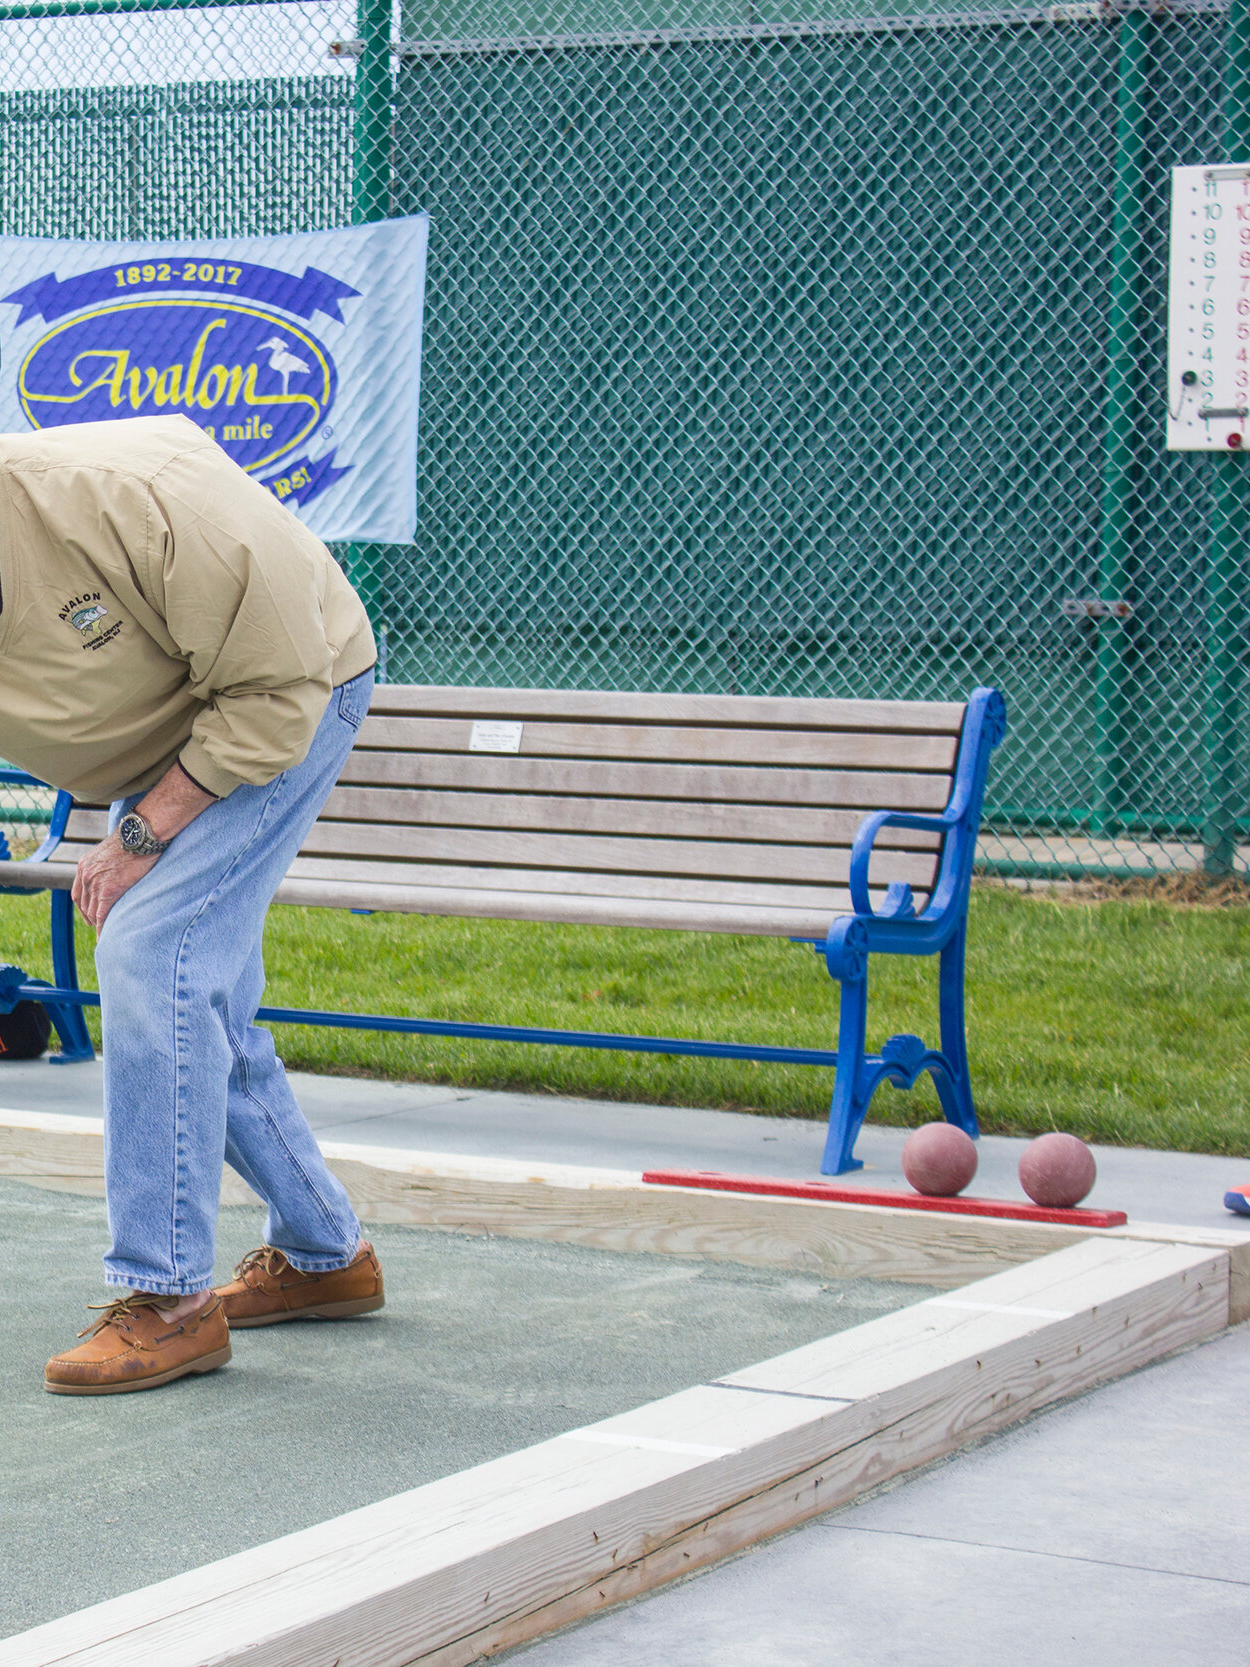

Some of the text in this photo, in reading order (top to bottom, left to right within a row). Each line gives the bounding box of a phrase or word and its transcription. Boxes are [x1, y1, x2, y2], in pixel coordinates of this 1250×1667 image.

[1203, 180, 1217, 197] 11
[1203, 203, 1222, 220] 10
[1203, 228, 1250, 245] 9 9
[1203, 251, 1250, 268] 8 8
[114, 263, 242, 287] 1892-2017
[1203, 275, 1250, 292] 7 7
[1202, 298, 1250, 316] 6 6
[1201, 322, 1249, 340] 5 5
[1201, 346, 1248, 362] 4 4
[69, 318, 259, 410] Avalon
[1200, 370, 1248, 387] 3 3
[1201, 392, 1248, 409] 2 2
[223, 415, 274, 441] mile
[58, 592, 101, 620] AVALON
[83, 620, 124, 650] FISHING CENTER
